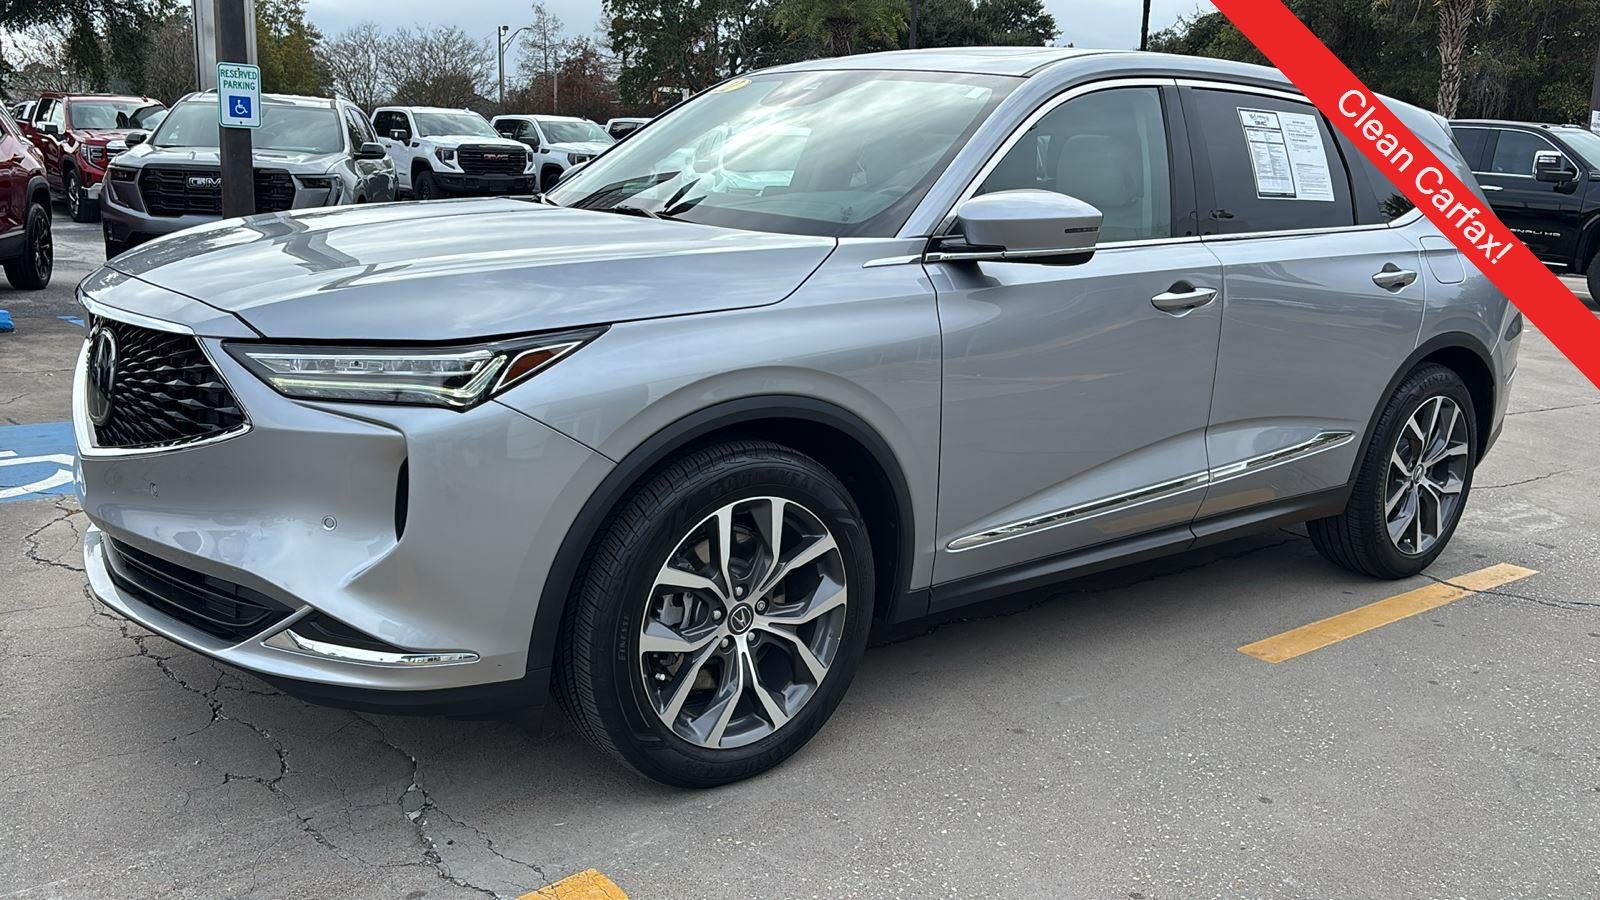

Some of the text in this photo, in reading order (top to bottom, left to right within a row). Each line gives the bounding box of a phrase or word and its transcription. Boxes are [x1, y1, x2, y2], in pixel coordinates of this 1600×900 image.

[220, 69, 257, 80] RESERVED
[223, 79, 256, 91] PARKING
[188, 176, 222, 189] GM
[1509, 228, 1543, 236] ENALI
